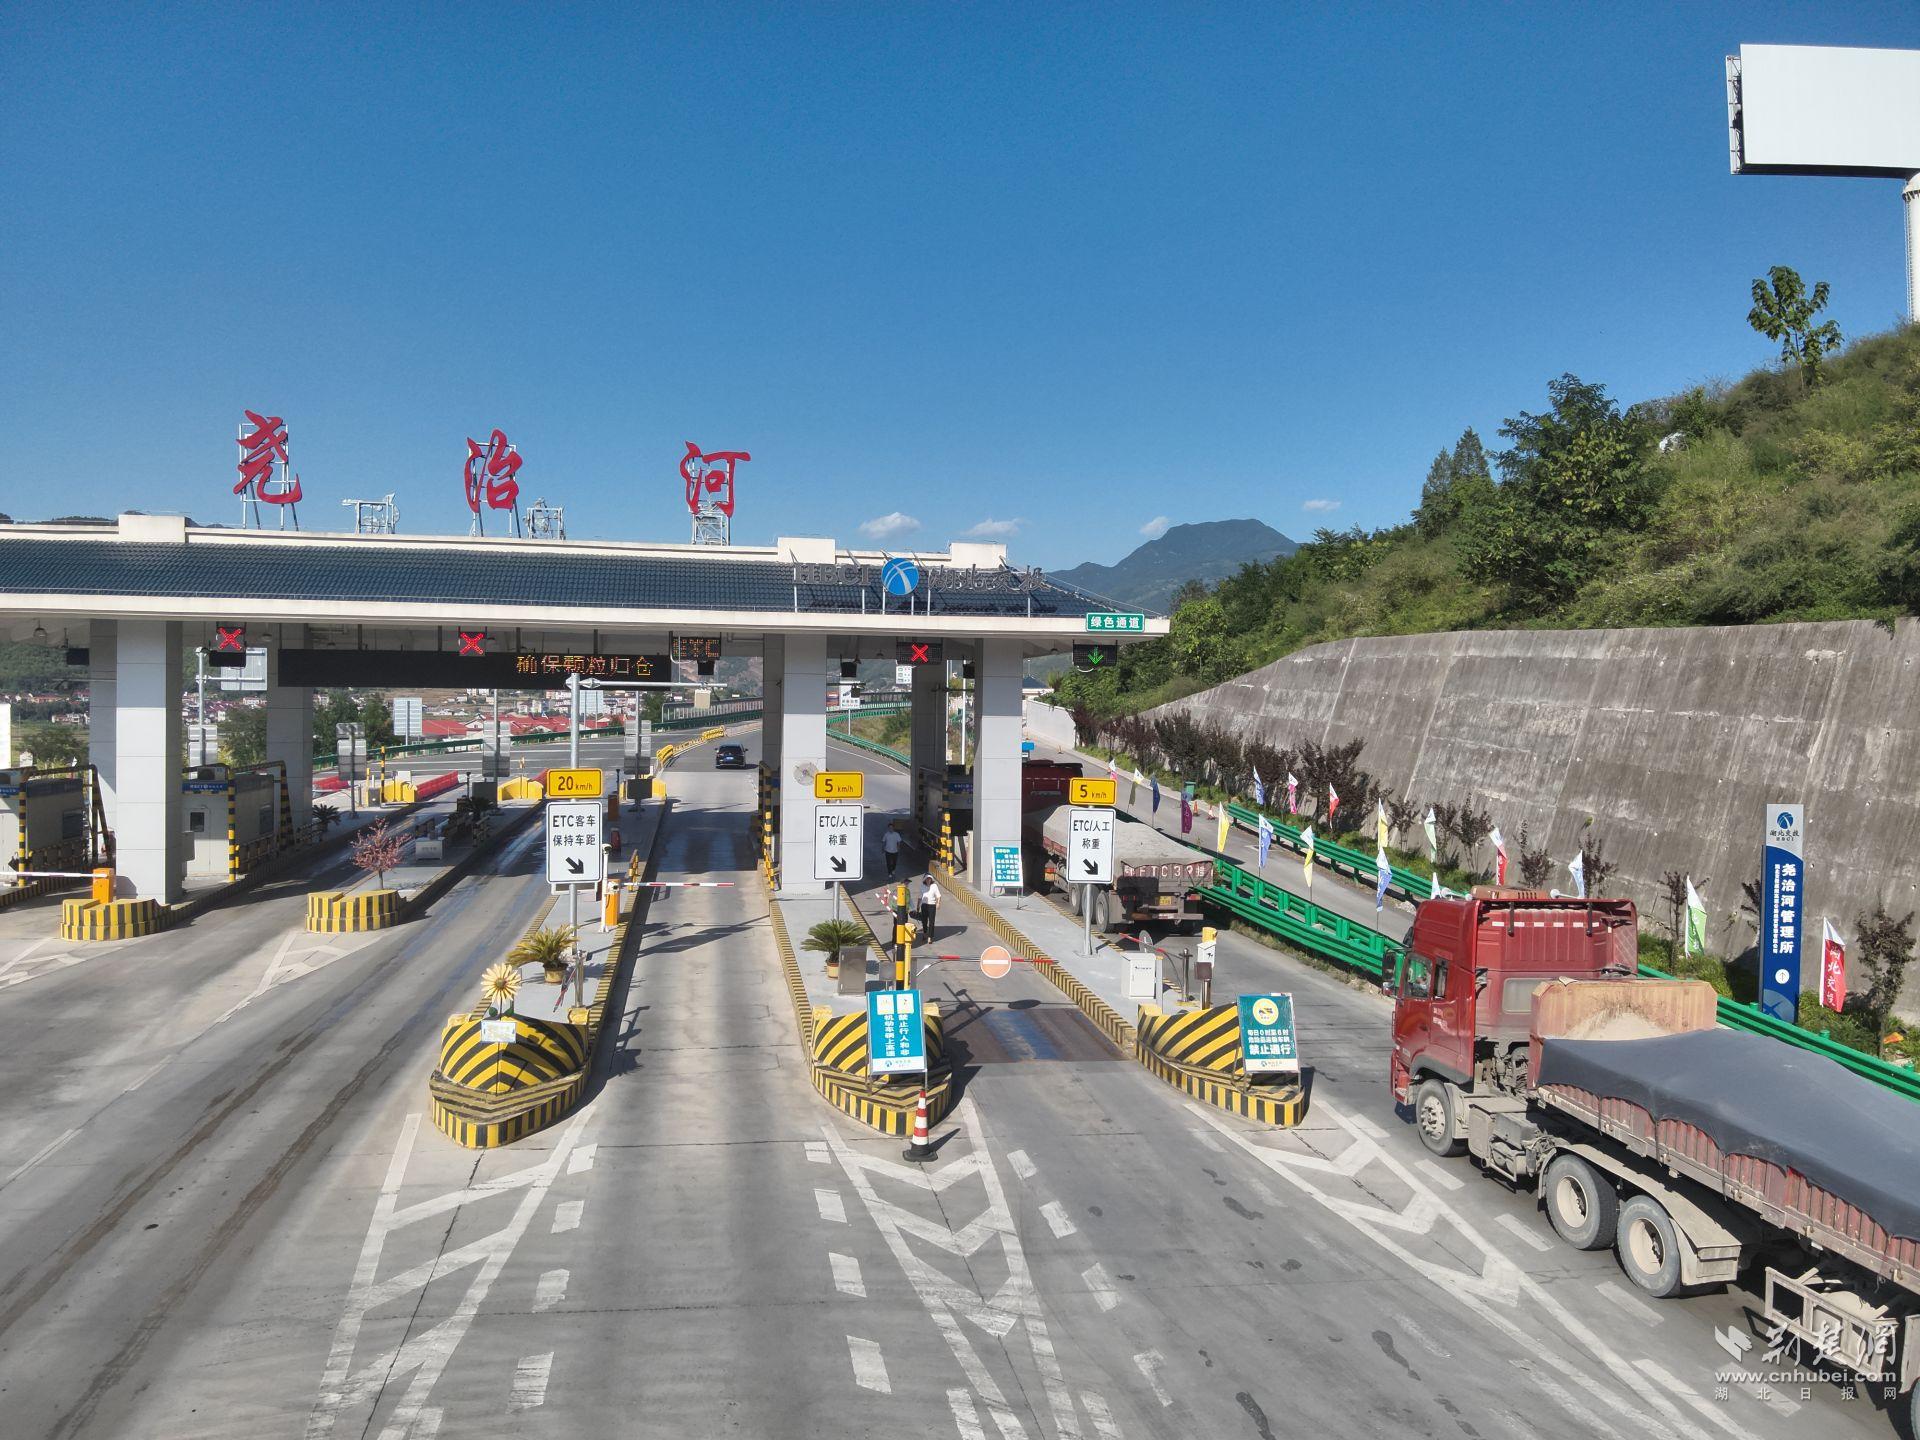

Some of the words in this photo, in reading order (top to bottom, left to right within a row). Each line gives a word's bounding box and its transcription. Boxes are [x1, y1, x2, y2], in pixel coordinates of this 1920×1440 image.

[233, 409, 751, 518] 尧治河
[1090, 616, 1140, 629] 绿色通道
[516, 655, 654, 676] 确保颗粒归仓
[558, 776, 574, 791] 20
[575, 783, 593, 791] km/h
[825, 779, 833, 793] 5
[837, 785, 854, 793] km/h
[1080, 784, 1088, 798] 5
[1091, 791, 1107, 799] km/h
[552, 815, 596, 828] ETC客车
[819, 815, 858, 828] ETC/人工
[1073, 820, 1110, 832] ETC/人工
[552, 834, 596, 847] 保持车距
[828, 833, 848, 846] 称重
[1082, 838, 1100, 850] 称重
[1779, 863, 1797, 954] 尧治河管理所
[1249, 1043, 1291, 1056] 禁止通行
